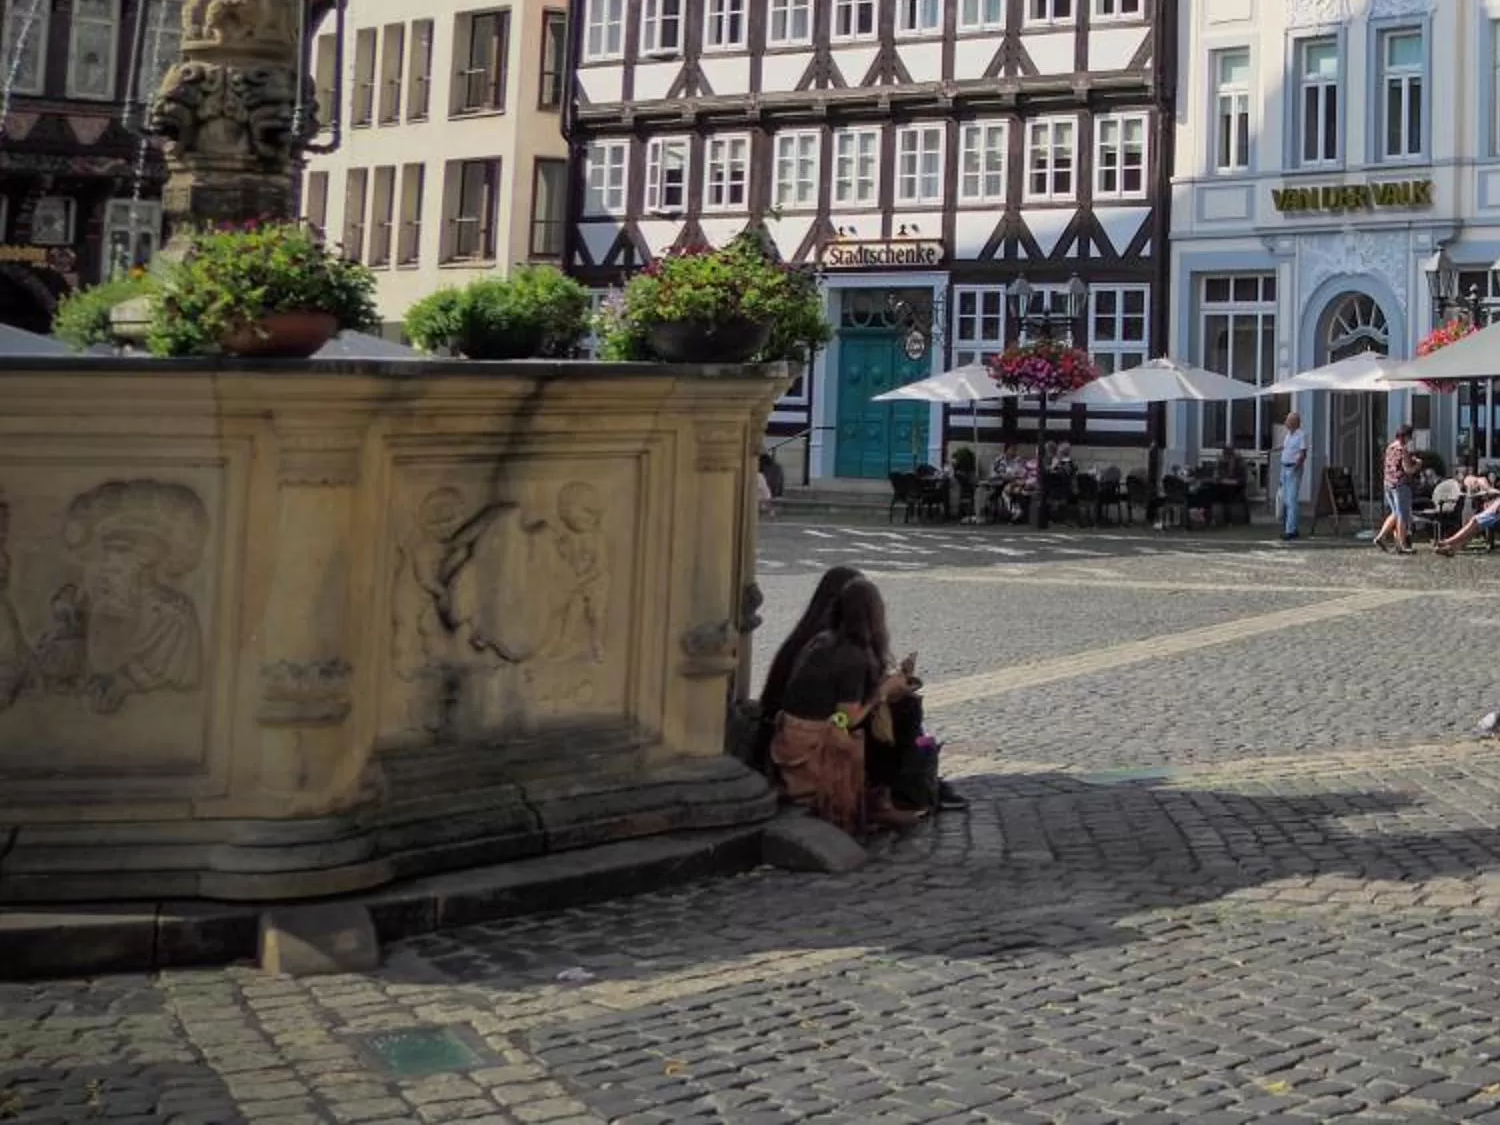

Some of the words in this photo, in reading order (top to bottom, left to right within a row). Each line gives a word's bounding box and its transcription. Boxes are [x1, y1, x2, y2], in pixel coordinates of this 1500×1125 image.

[1271, 188, 1319, 211] VAN
[1322, 185, 1369, 209] DER
[1371, 180, 1433, 206] VALK
[830, 243, 935, 265] Stadtschenke
